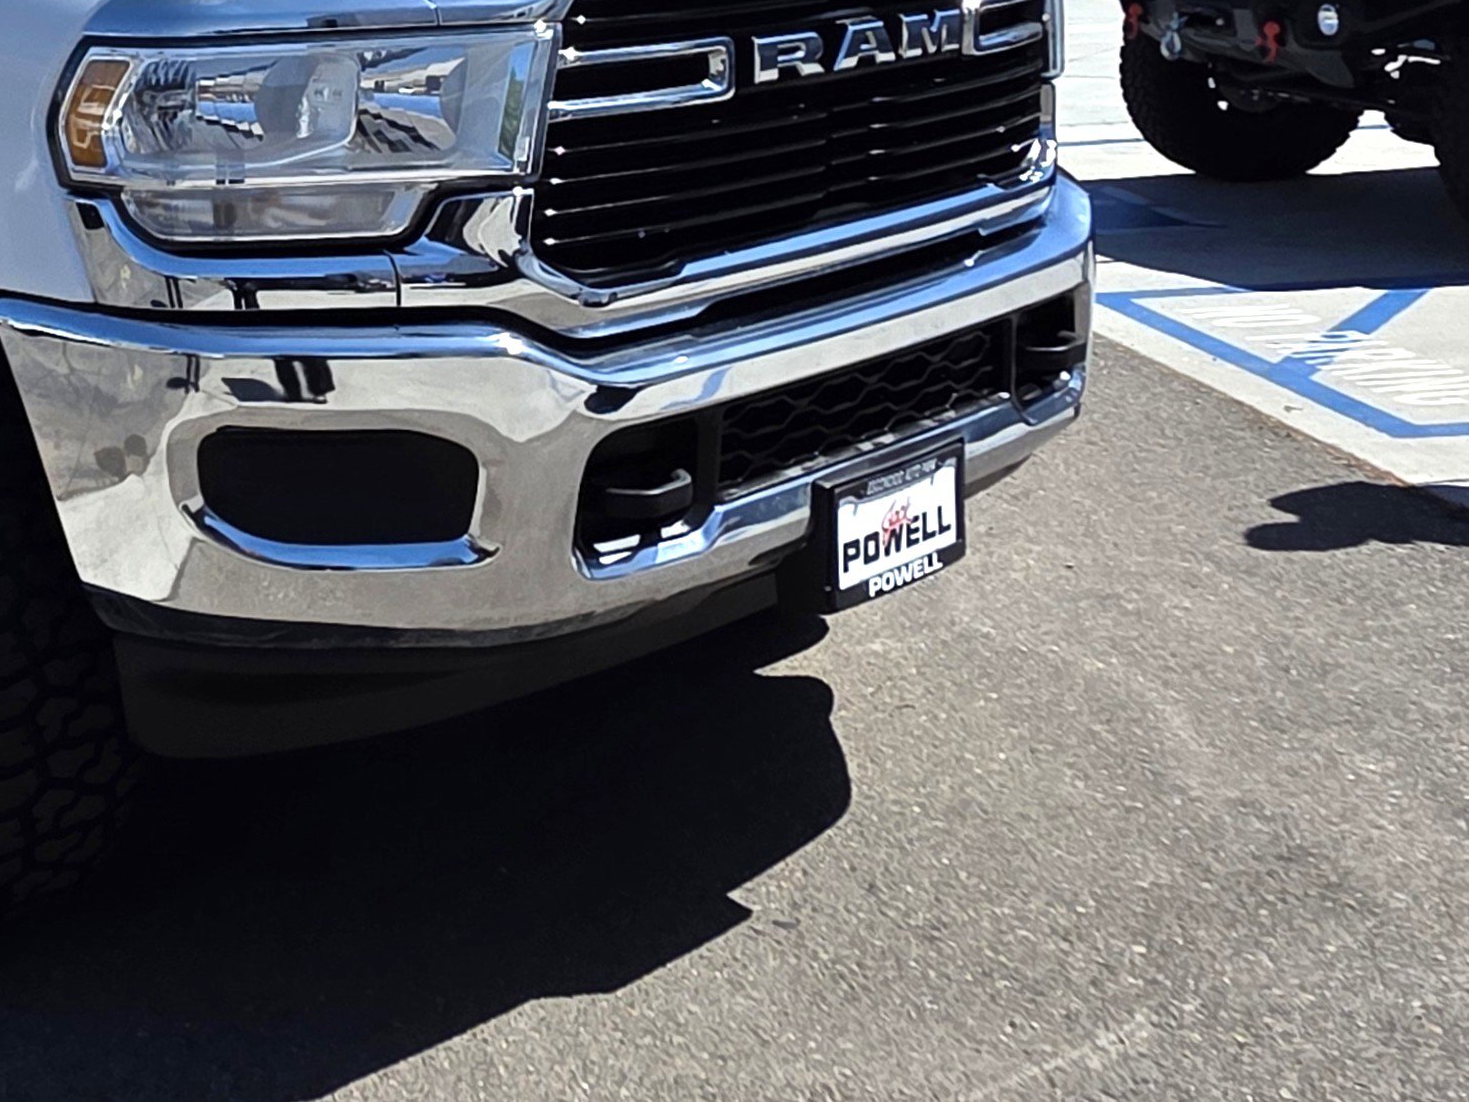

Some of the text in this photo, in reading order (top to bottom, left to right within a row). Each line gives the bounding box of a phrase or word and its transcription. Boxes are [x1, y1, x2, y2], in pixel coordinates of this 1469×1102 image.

[751, 8, 961, 84] RAM
[1245, 329, 1469, 406] PARKING
[843, 505, 952, 574] POWELL
[868, 550, 944, 598] POWELL
